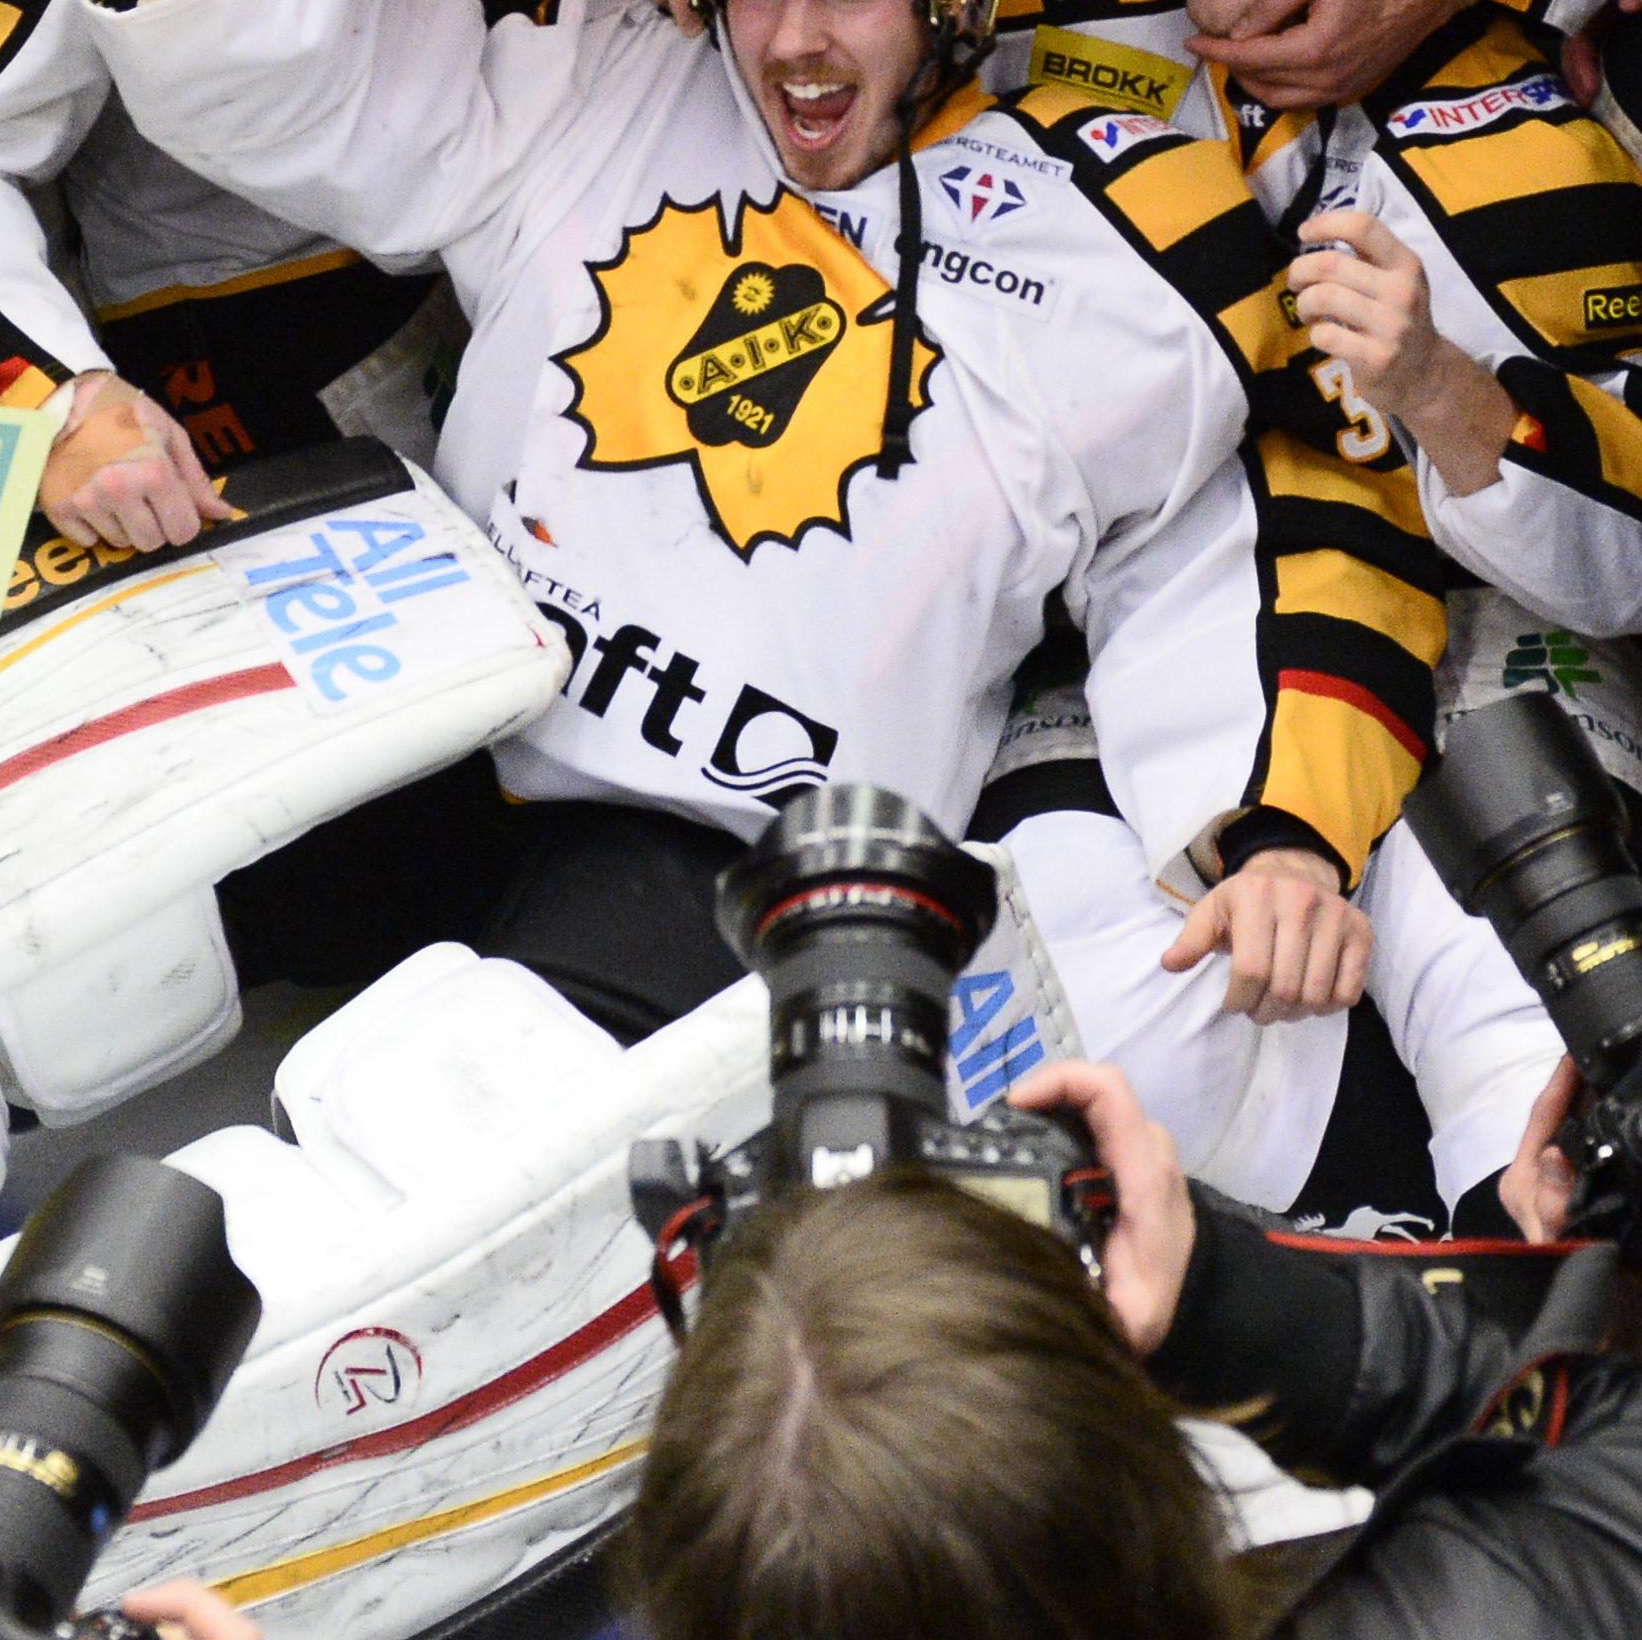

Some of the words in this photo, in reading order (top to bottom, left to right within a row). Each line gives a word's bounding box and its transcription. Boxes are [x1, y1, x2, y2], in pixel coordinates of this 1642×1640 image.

[1041, 51, 1170, 108] BROKK
[726, 392, 774, 436] 1921
[325, 518, 472, 606] All
[243, 531, 403, 703] Tele
